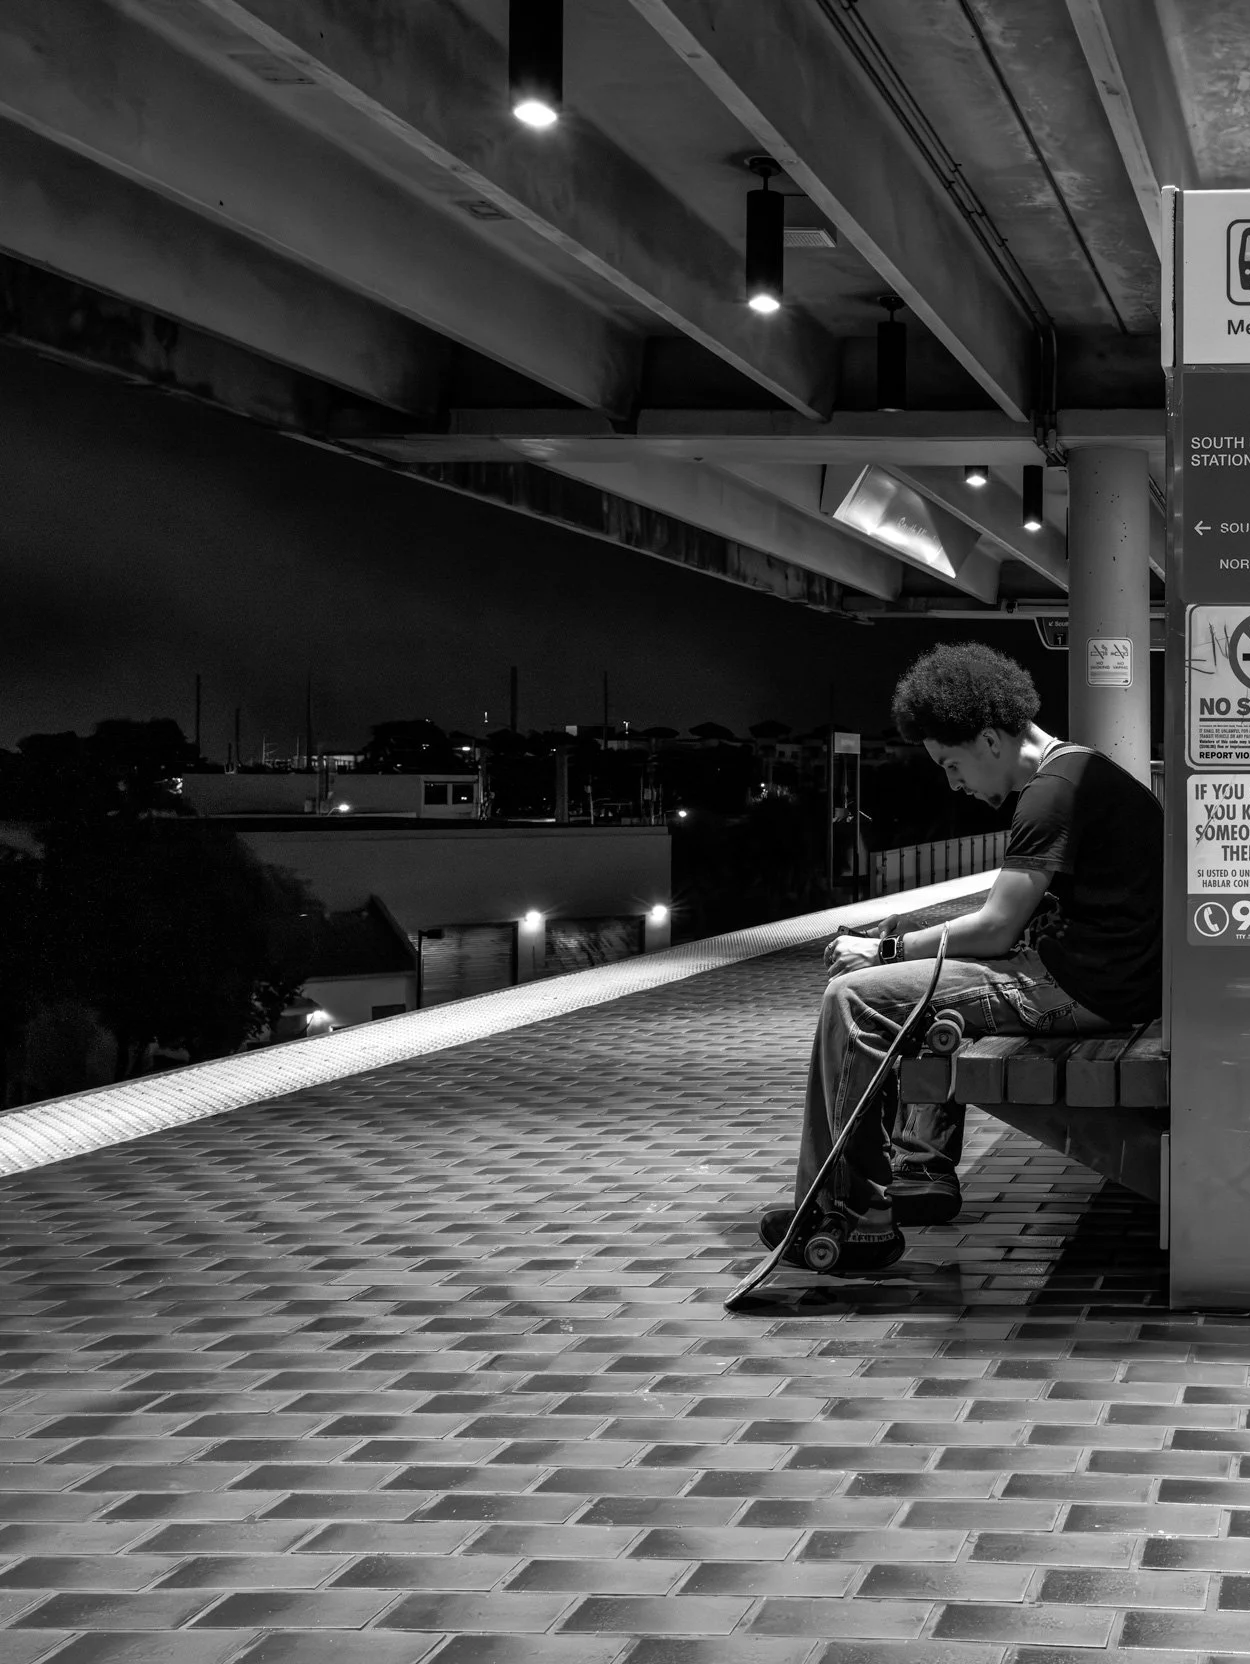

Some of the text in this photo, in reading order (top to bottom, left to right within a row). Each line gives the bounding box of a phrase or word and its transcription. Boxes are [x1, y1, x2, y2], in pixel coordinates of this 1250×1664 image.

[1191, 436, 1244, 449] SOUTH
[1200, 698, 1231, 716] NO
[1195, 784, 1207, 800] IF
[1212, 784, 1244, 800] YOU
[1204, 804, 1236, 821] YOU
[1197, 869, 1204, 878] SI
[1206, 869, 1229, 878] USTED
[1231, 869, 1237, 878] O
[1239, 869, 1250, 878] UN
[1202, 879, 1231, 888] HABLAR
[1233, 879, 1249, 888] CON
